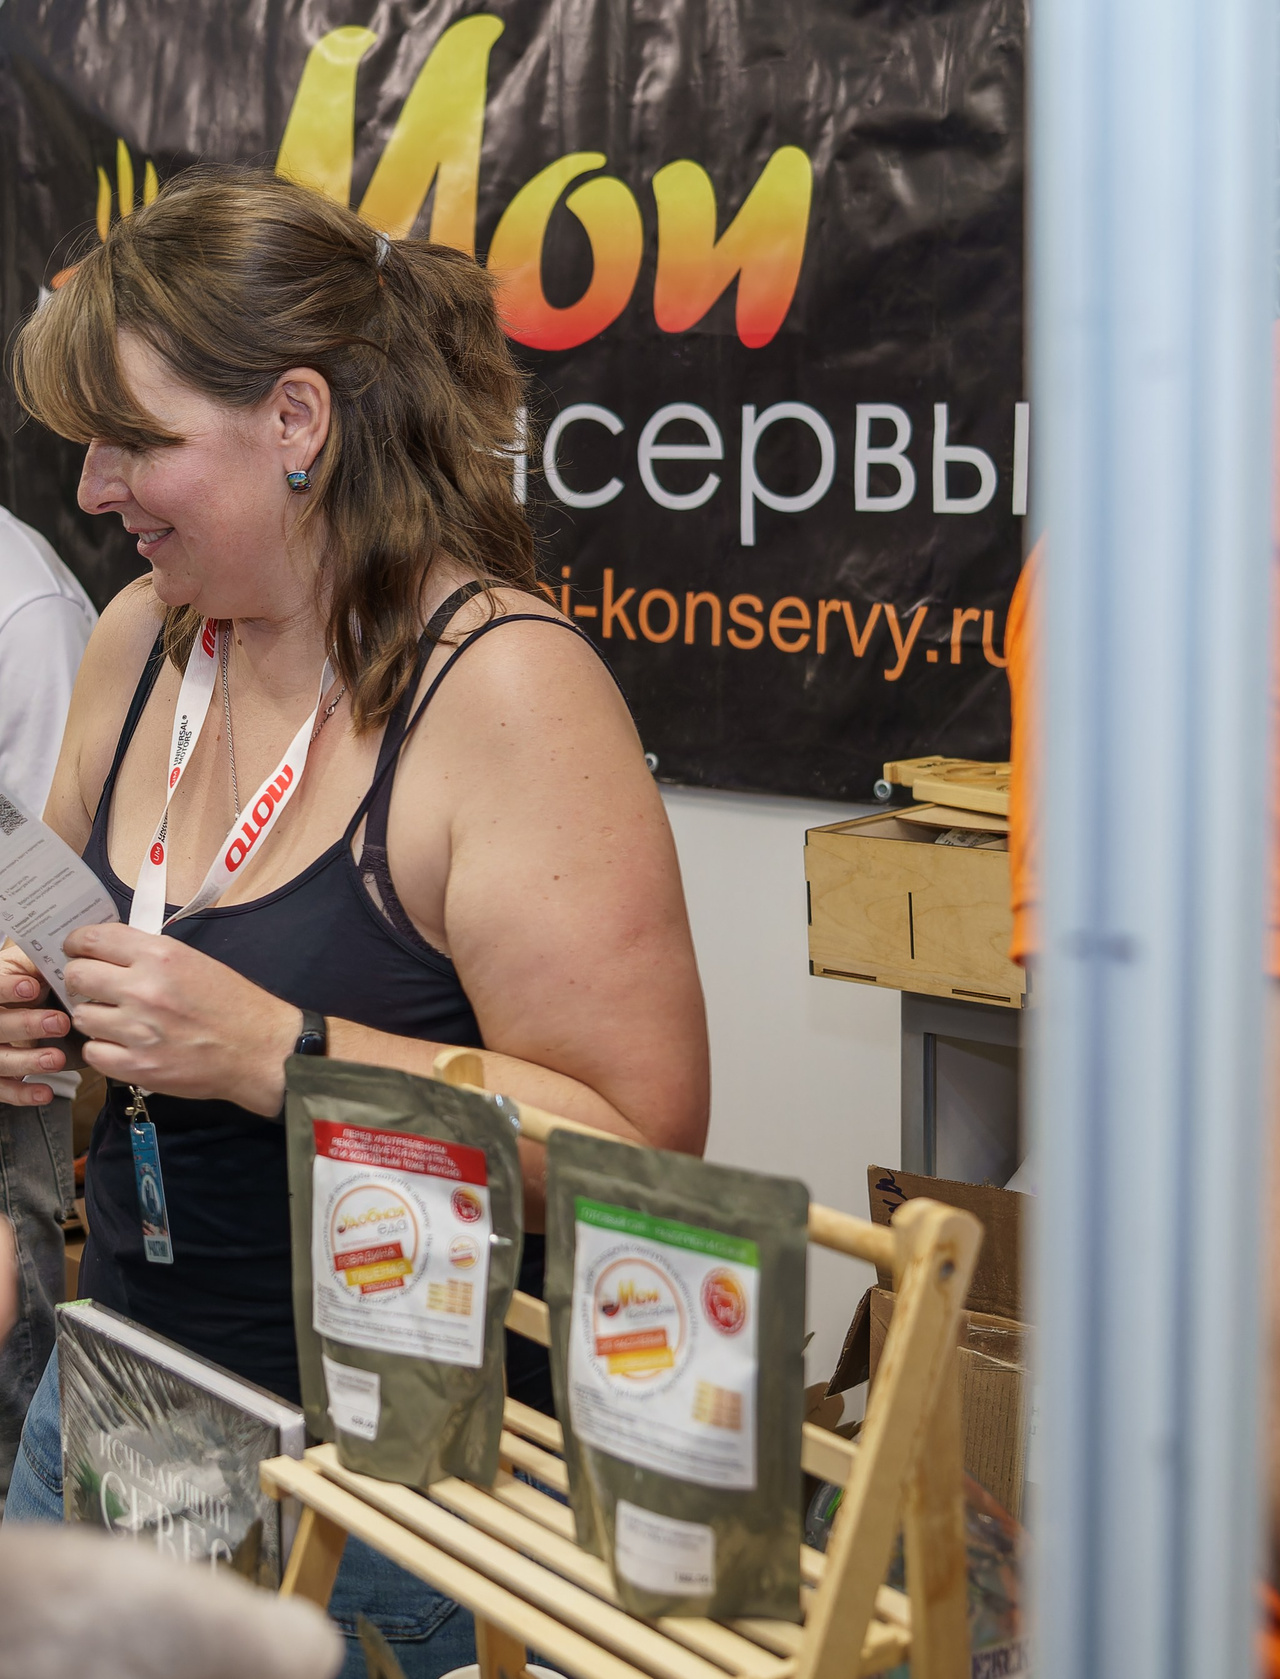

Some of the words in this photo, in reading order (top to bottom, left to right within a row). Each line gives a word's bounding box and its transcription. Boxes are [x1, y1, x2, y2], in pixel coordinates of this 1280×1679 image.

[275, 13, 813, 351] Мои
[538, 566, 1010, 681] i-konservy.ru
[225, 764, 294, 873] MOTO
